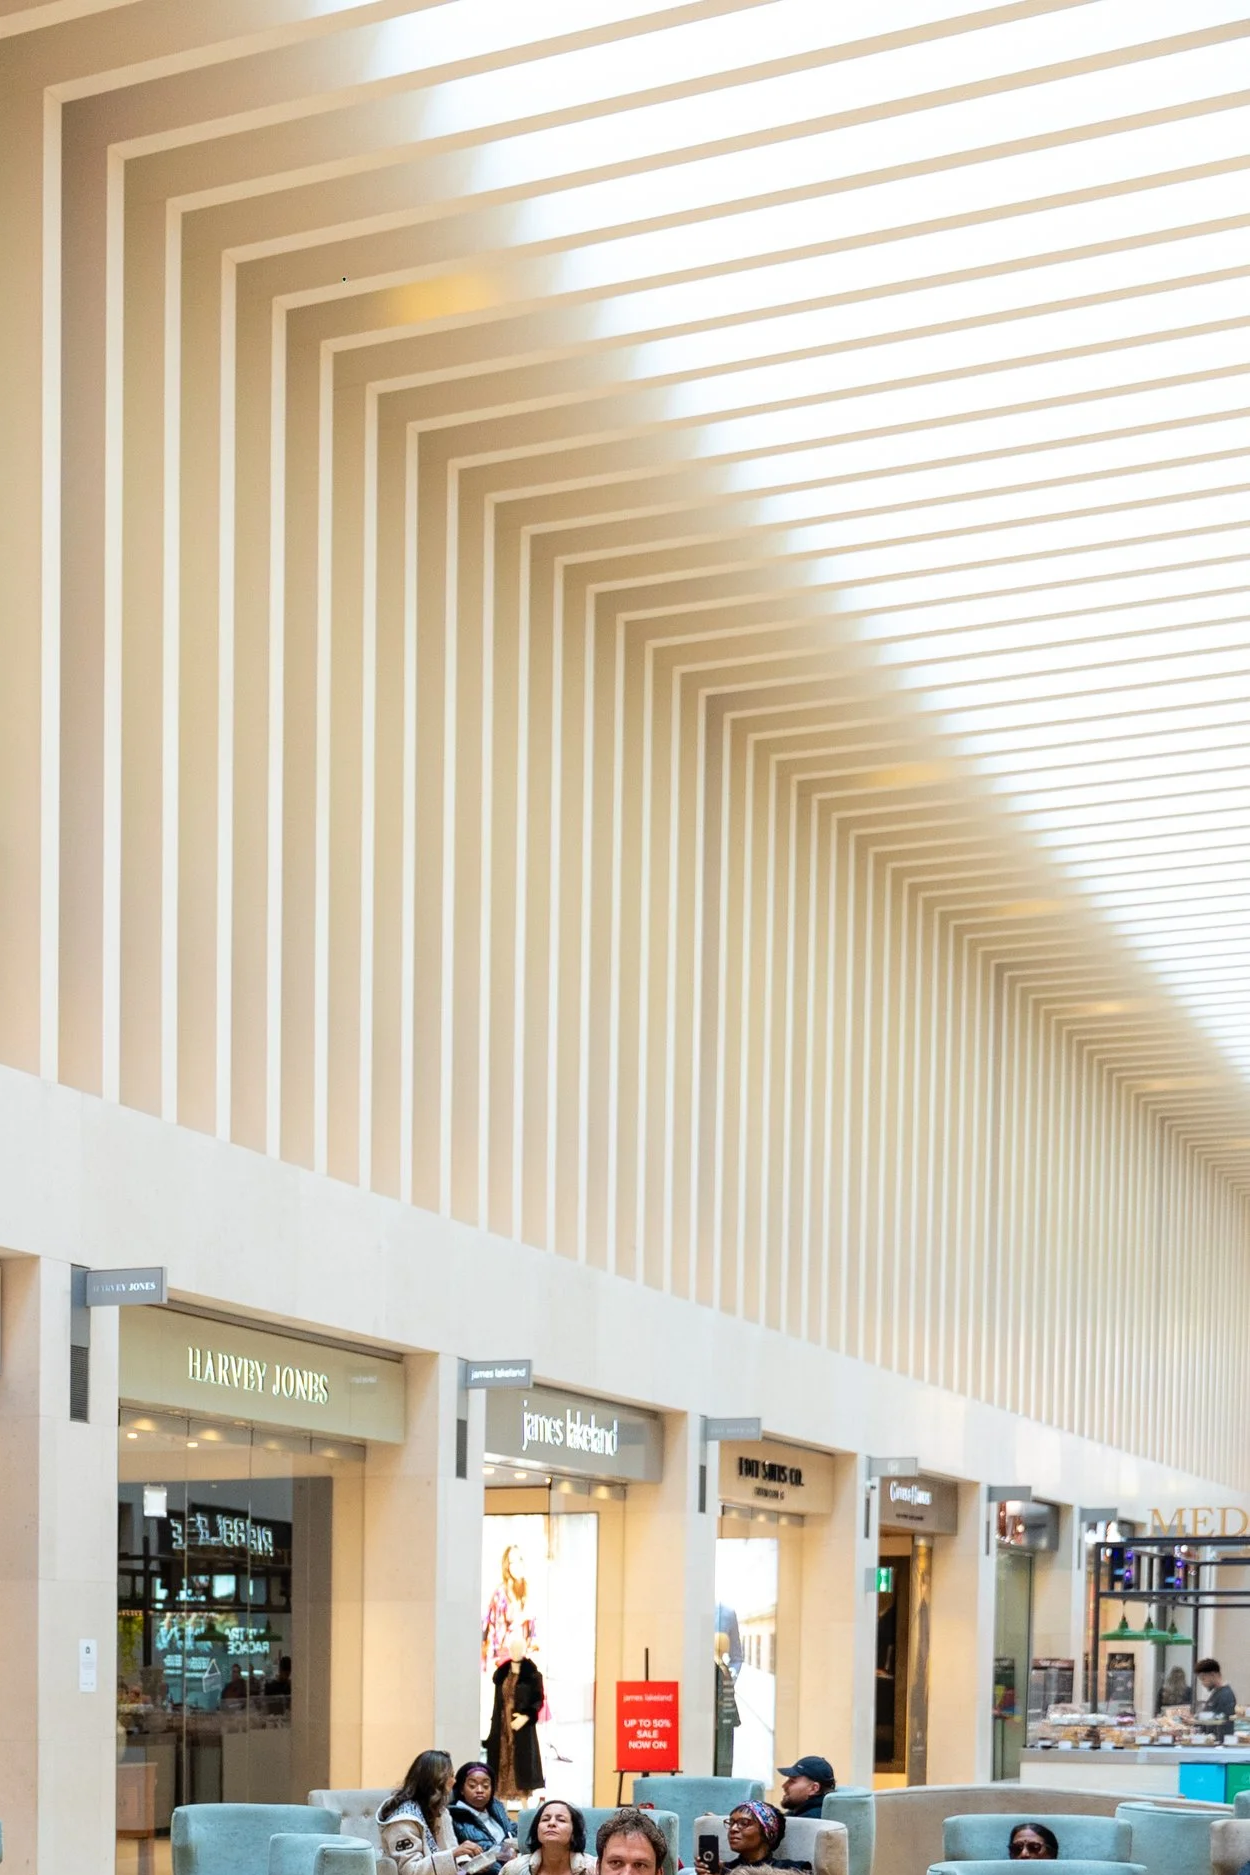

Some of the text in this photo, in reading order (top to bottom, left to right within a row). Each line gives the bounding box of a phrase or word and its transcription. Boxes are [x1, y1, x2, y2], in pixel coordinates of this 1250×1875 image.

[93, 1280, 157, 1293] HARVEY JONES
[187, 1346, 330, 1405] HARVEY JONES
[471, 1366, 527, 1381] james lakeland
[522, 1400, 619, 1457] james lakeland
[623, 1718, 672, 1728] UP TO 50%
[636, 1729, 659, 1739] SALE
[628, 1740, 668, 1750] NOW ON
